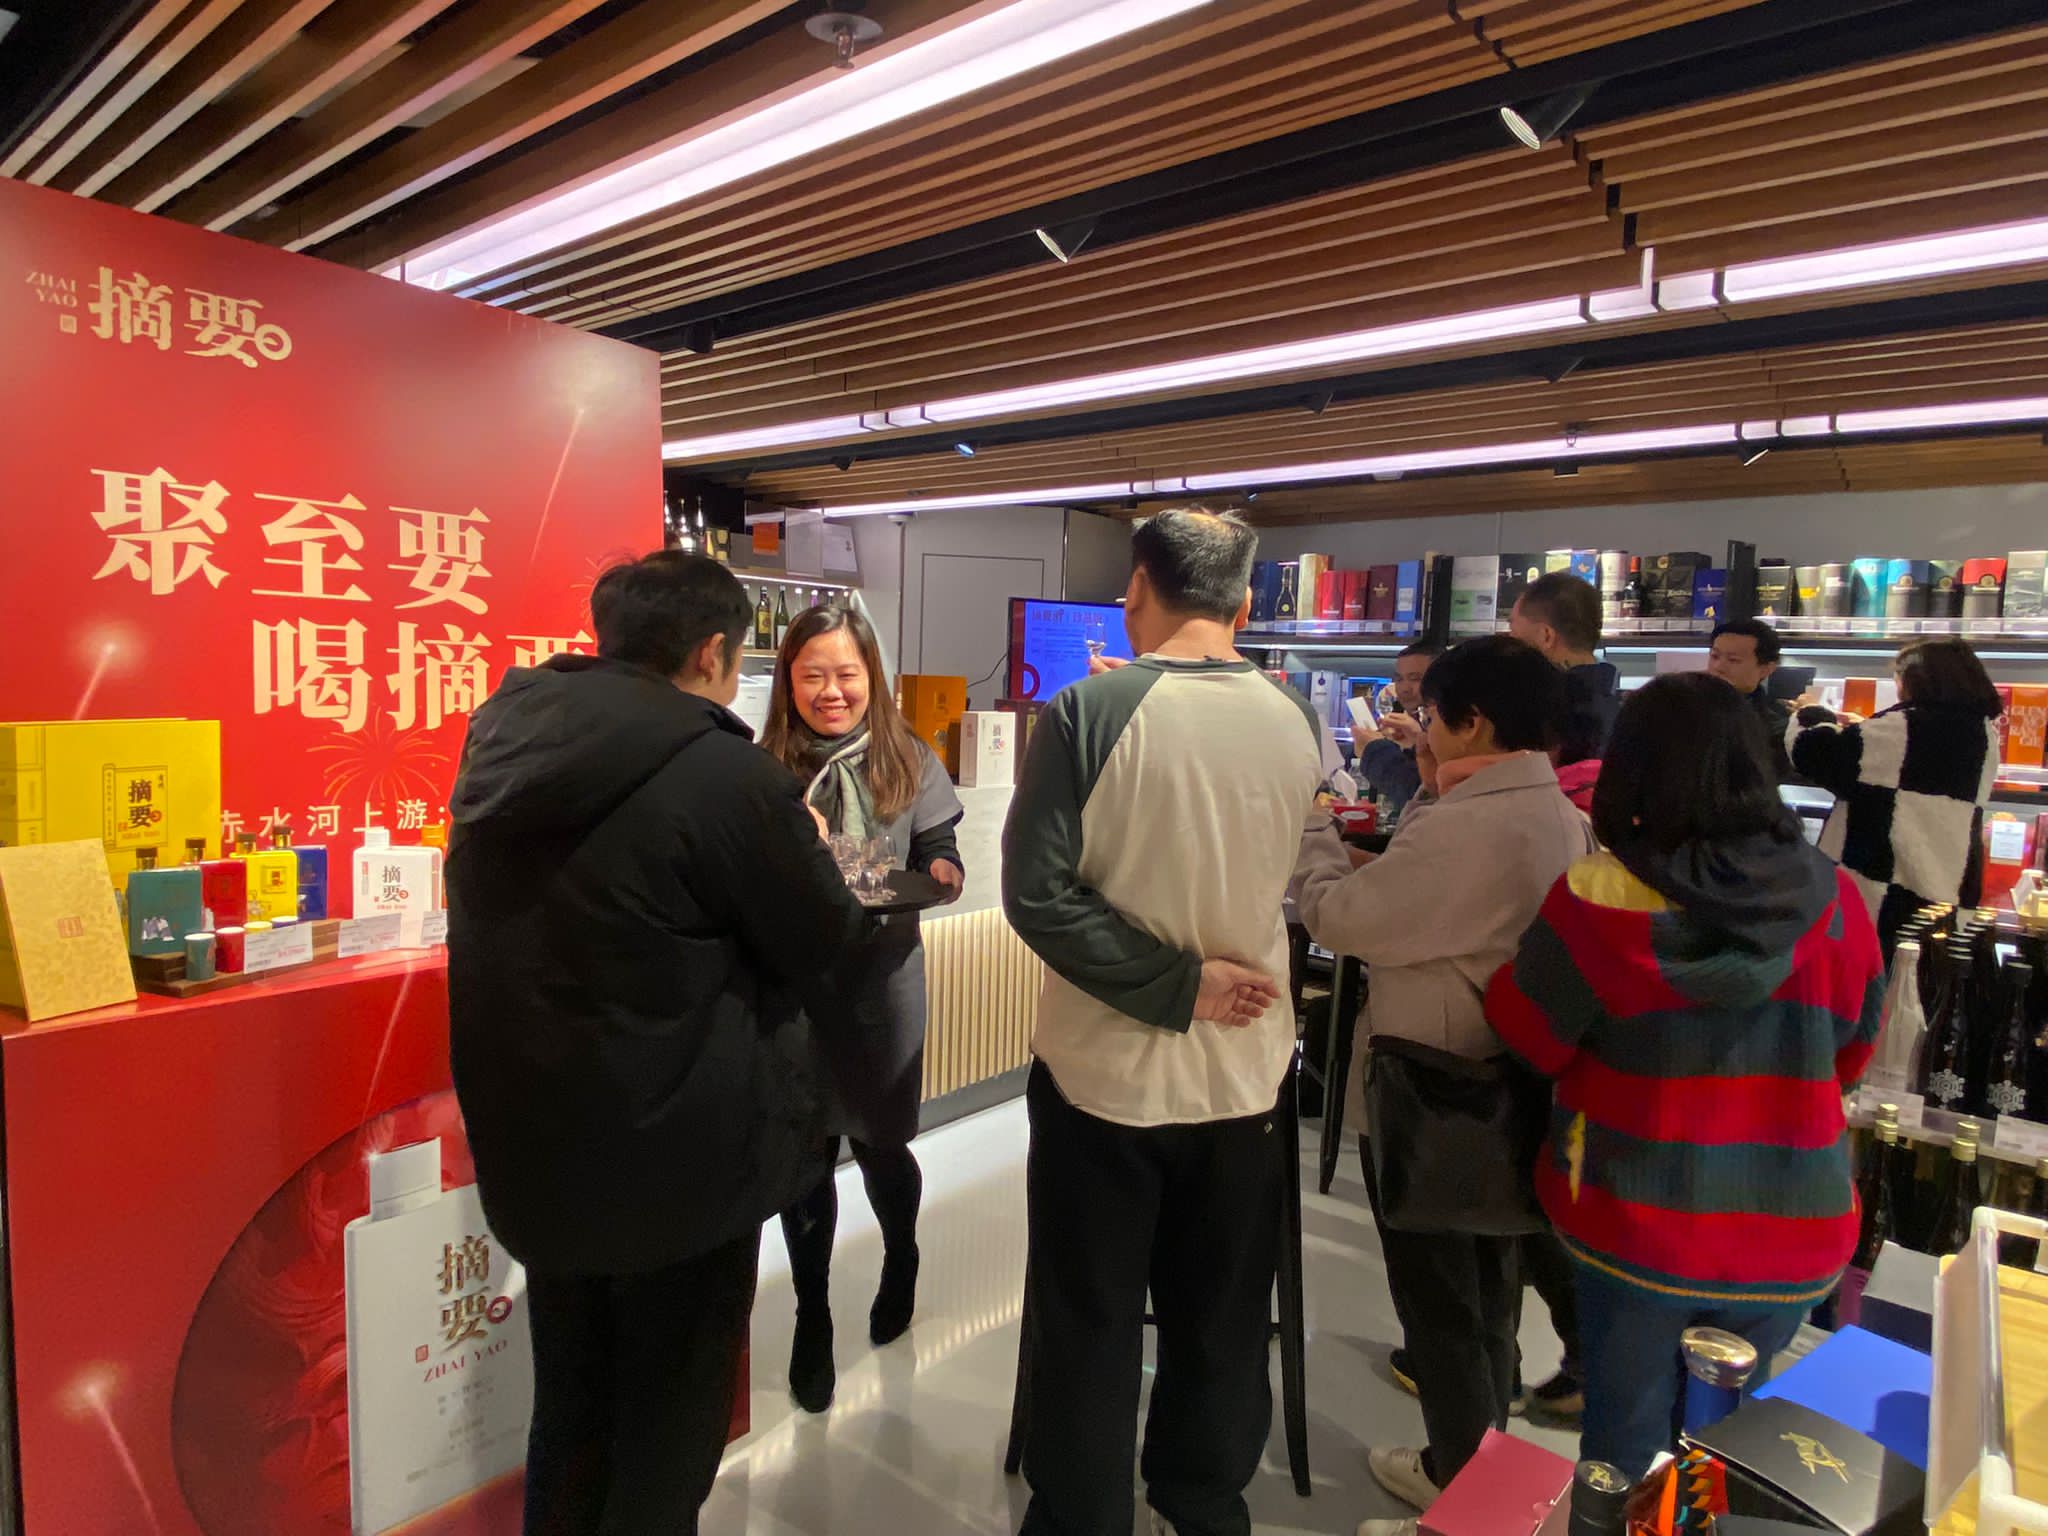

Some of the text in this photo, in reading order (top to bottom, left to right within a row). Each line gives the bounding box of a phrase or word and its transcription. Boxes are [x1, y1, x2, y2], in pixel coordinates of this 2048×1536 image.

[25, 271, 77, 292] ZHAI
[35, 288, 78, 308] YAO
[88, 265, 265, 369] 摘要
[90, 466, 494, 615] 聚至要
[127, 778, 153, 829] 摘要
[382, 864, 401, 903] 摘要
[436, 1234, 492, 1353] 摘要
[424, 1355, 465, 1382] ZHAI
